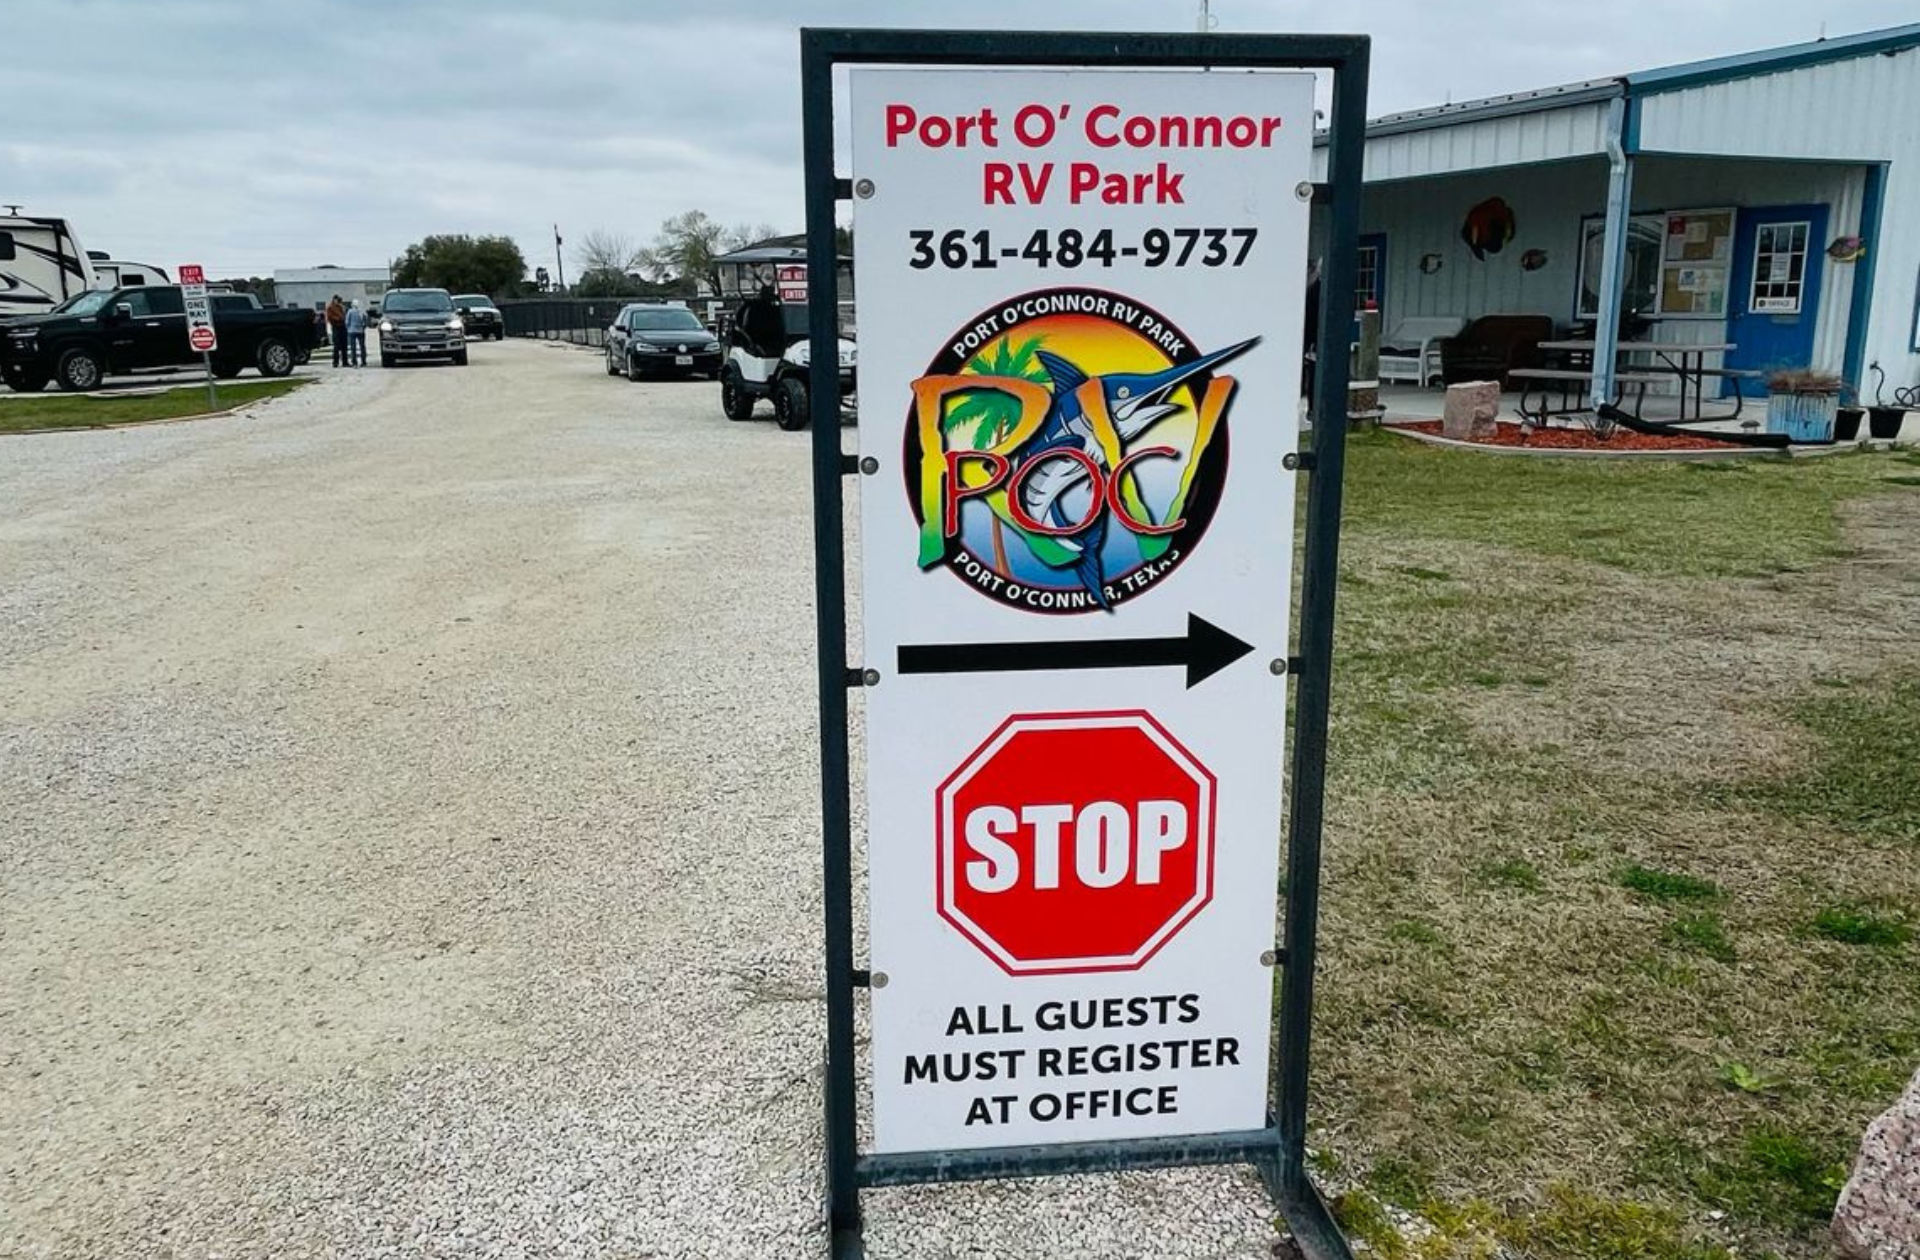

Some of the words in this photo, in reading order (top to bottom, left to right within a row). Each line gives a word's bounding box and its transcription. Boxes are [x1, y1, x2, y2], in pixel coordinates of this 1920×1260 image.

[886, 104, 998, 147] Port
[1014, 104, 1071, 147] O'
[1085, 104, 1281, 148] Connor
[984, 163, 1054, 204] RV
[1070, 163, 1184, 204] Park
[909, 228, 1258, 269] 361-484-9737
[187, 301, 205, 309] ONE
[188, 310, 207, 318] WAY
[953, 315, 1000, 358] PORT
[1003, 295, 1108, 324] O'CONNOR
[1112, 302, 1139, 322] RV
[1139, 315, 1186, 357] PARK
[944, 446, 1186, 538] POC
[954, 551, 1005, 592] PORT
[964, 799, 1188, 893] STOP
[945, 1004, 1023, 1036] ALL
[1035, 994, 1200, 1031] GUESTS
[904, 1050, 1025, 1084] MUST
[1039, 1037, 1240, 1077] REGISTER
[965, 1096, 1018, 1126] AT
[1029, 1086, 1178, 1122] OFFICE
